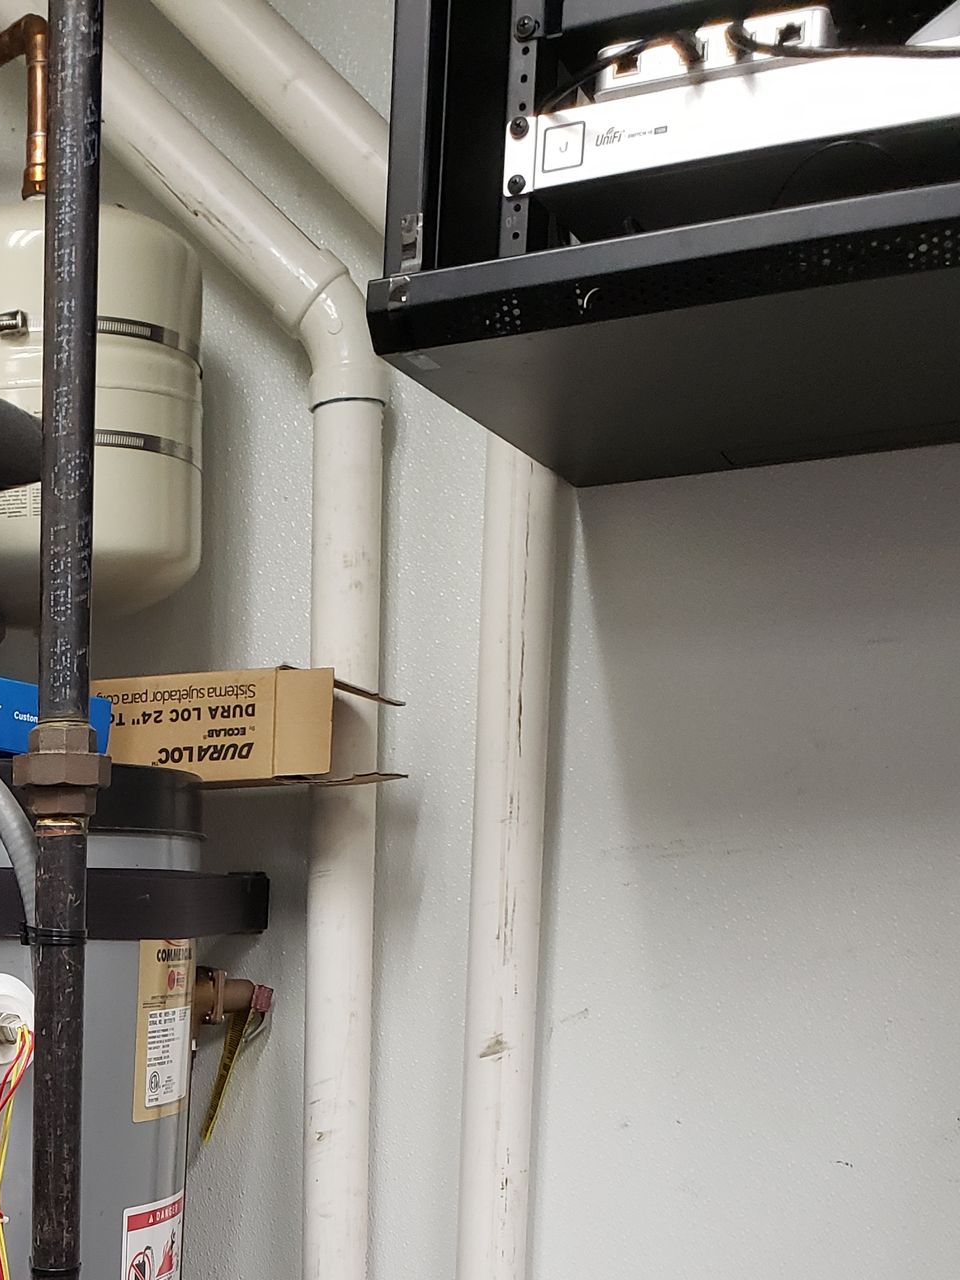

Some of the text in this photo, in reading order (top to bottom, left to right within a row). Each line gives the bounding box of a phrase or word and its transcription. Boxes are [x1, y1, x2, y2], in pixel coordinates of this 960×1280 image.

[595, 128, 622, 147] UniFi
[121, 689, 148, 704] para
[151, 685, 206, 703] sujetador
[207, 683, 256, 699] Sistema
[170, 707, 201, 722] LOC
[208, 703, 256, 720] DURA
